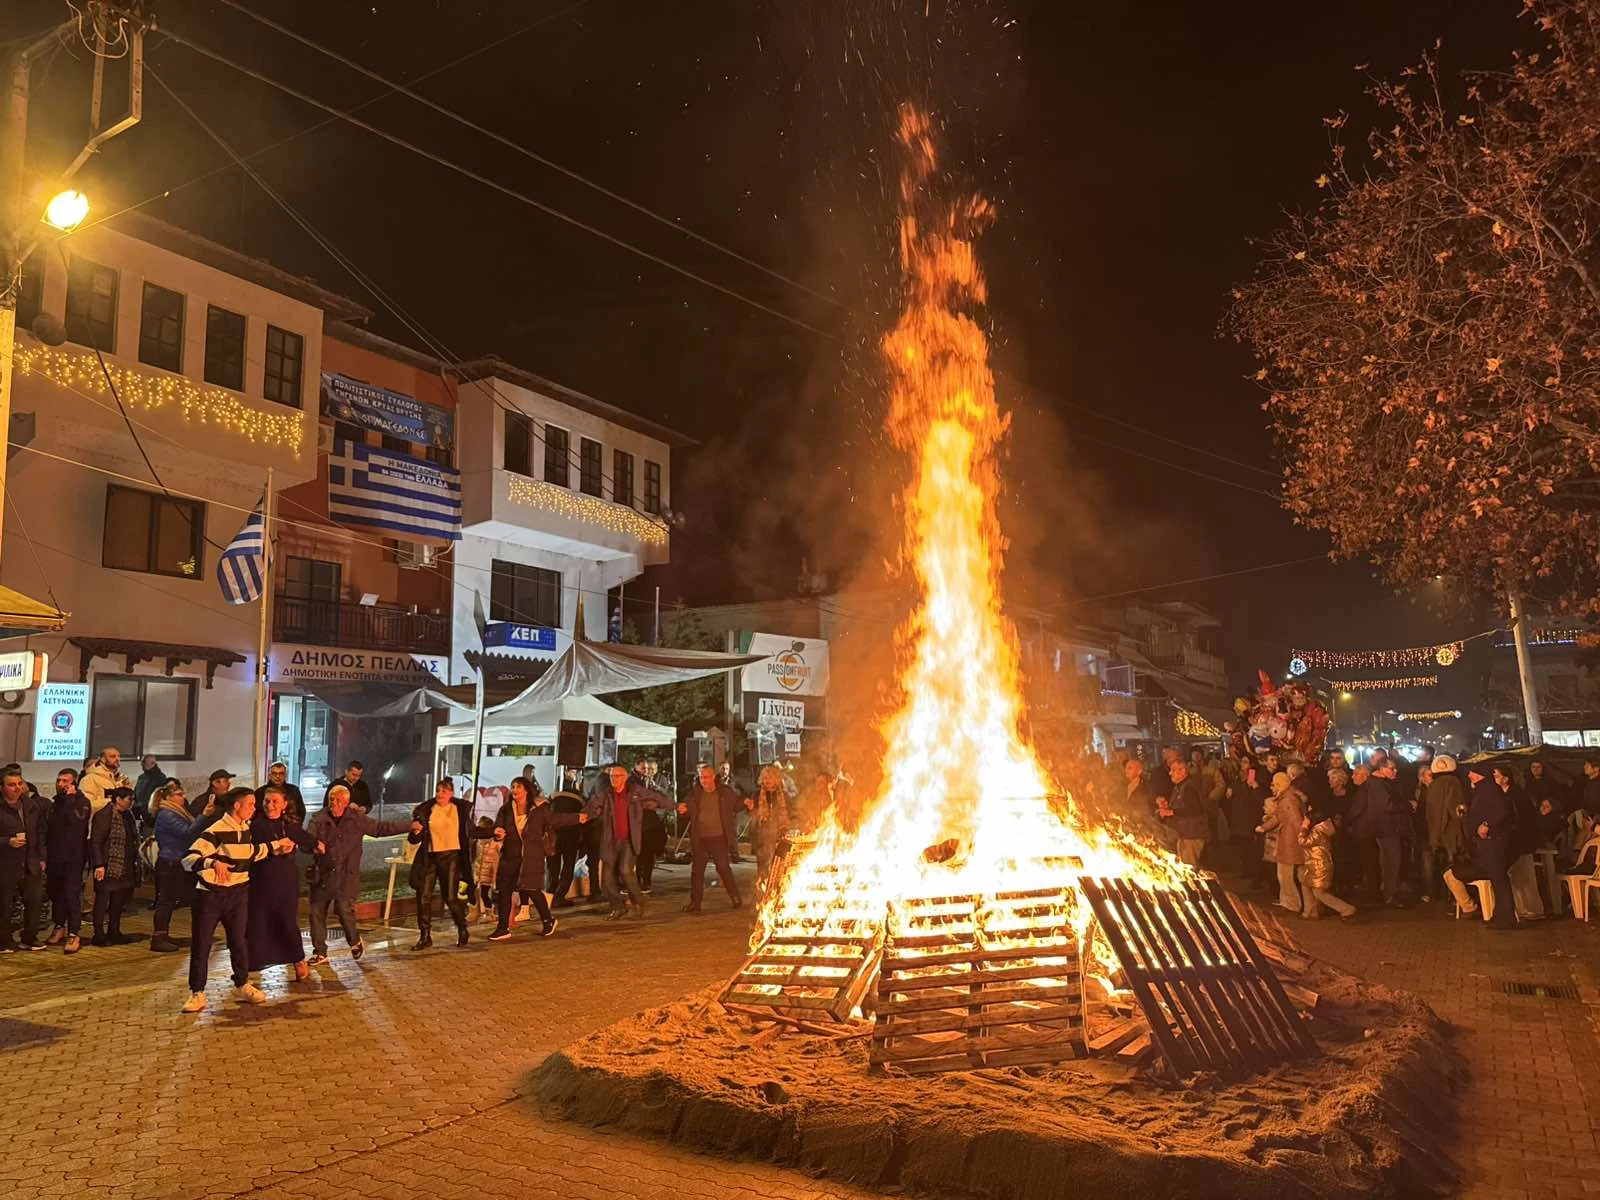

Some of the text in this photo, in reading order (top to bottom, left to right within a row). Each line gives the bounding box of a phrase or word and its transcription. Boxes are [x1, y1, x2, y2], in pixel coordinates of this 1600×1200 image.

[415, 474, 448, 489] ΕΛΛΑΔΑ
[511, 627, 540, 642] ΚΕΠ
[291, 650, 439, 673] ΔΗΜΟΣ ΠΕΛΛΑΣ
[282, 668, 337, 679] ΔΗΜΟΤΙΚΗ
[339, 671, 381, 682] ΕΝΟΤΗΤΑ
[43, 688, 85, 696] ΕΛΛΗΝΙΚΗ
[43, 697, 85, 705] ΑΣΤΥΝΟΜΙΑ
[761, 701, 802, 720] Living
